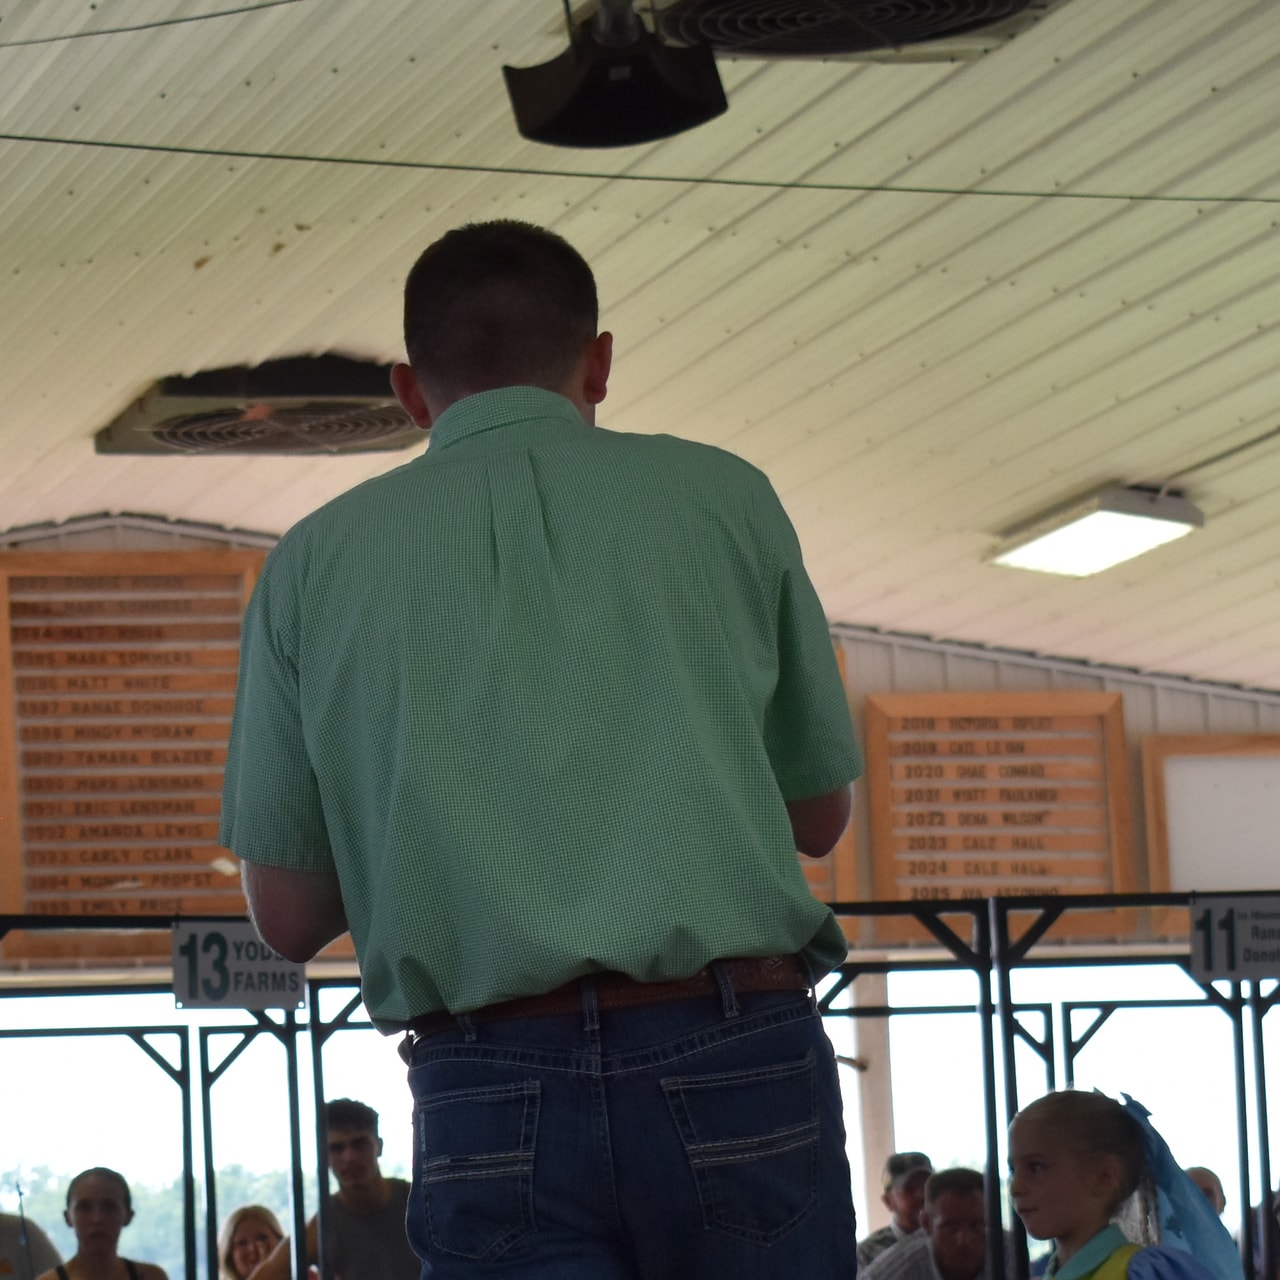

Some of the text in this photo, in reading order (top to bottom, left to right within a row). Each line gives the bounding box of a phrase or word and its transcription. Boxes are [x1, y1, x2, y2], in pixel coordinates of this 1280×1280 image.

[67, 652, 192, 664] MARK SOMMERS
[67, 676, 170, 689] MATT WHITE
[77, 752, 139, 763] TAMARA
[905, 765, 944, 779] 2020
[905, 788, 941, 802] 2021
[999, 788, 1057, 802] FAULKNER
[75, 802, 108, 816] ERIC
[121, 801, 194, 815] LENSMAN
[906, 812, 945, 826] 2022
[79, 825, 144, 838] AMANDA
[155, 824, 202, 837] LEWIS
[908, 836, 947, 850] 2023
[1011, 836, 1045, 849] HALL
[80, 849, 130, 863] CARLY
[143, 848, 193, 861] CLARK
[909, 860, 948, 876] 2024
[964, 861, 999, 876] CALE
[82, 900, 127, 913] EMILY
[1194, 907, 1235, 973] 11
[179, 932, 230, 1000] 13
[233, 971, 300, 993] FARMS
